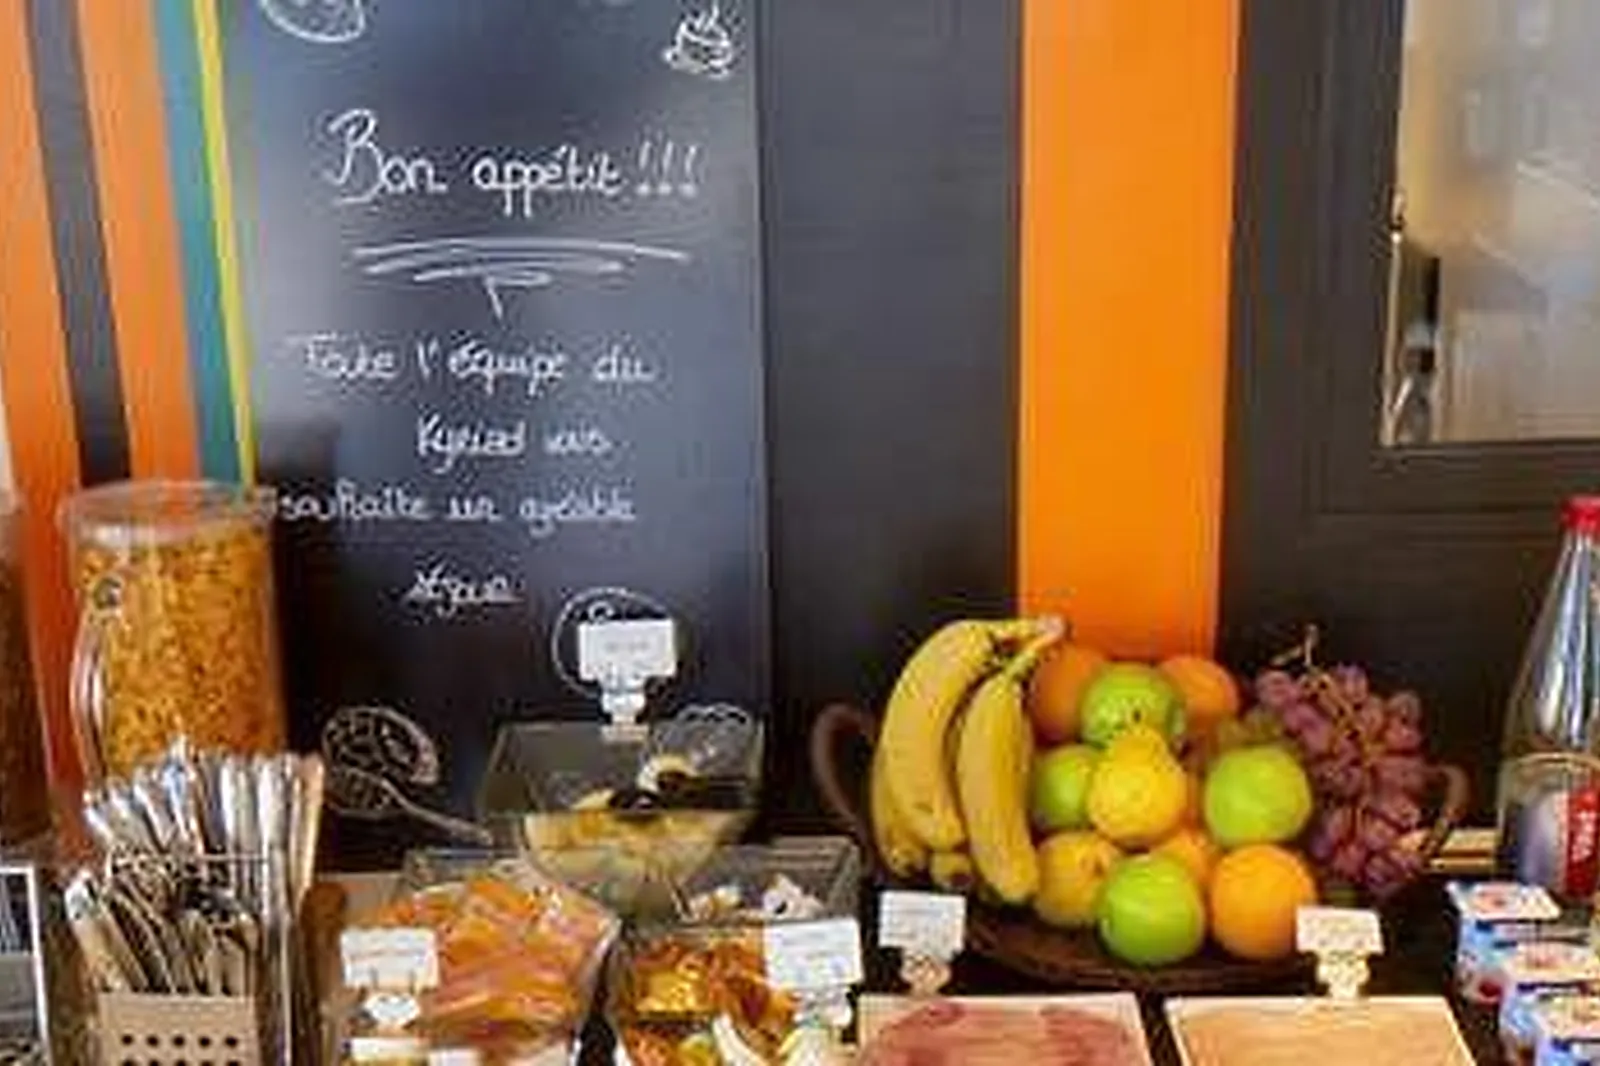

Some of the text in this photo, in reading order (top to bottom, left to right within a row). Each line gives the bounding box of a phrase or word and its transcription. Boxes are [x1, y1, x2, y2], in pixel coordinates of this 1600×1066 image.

[328, 108, 447, 205] Bon
[471, 144, 622, 218] appétit
[594, 345, 654, 384] du
